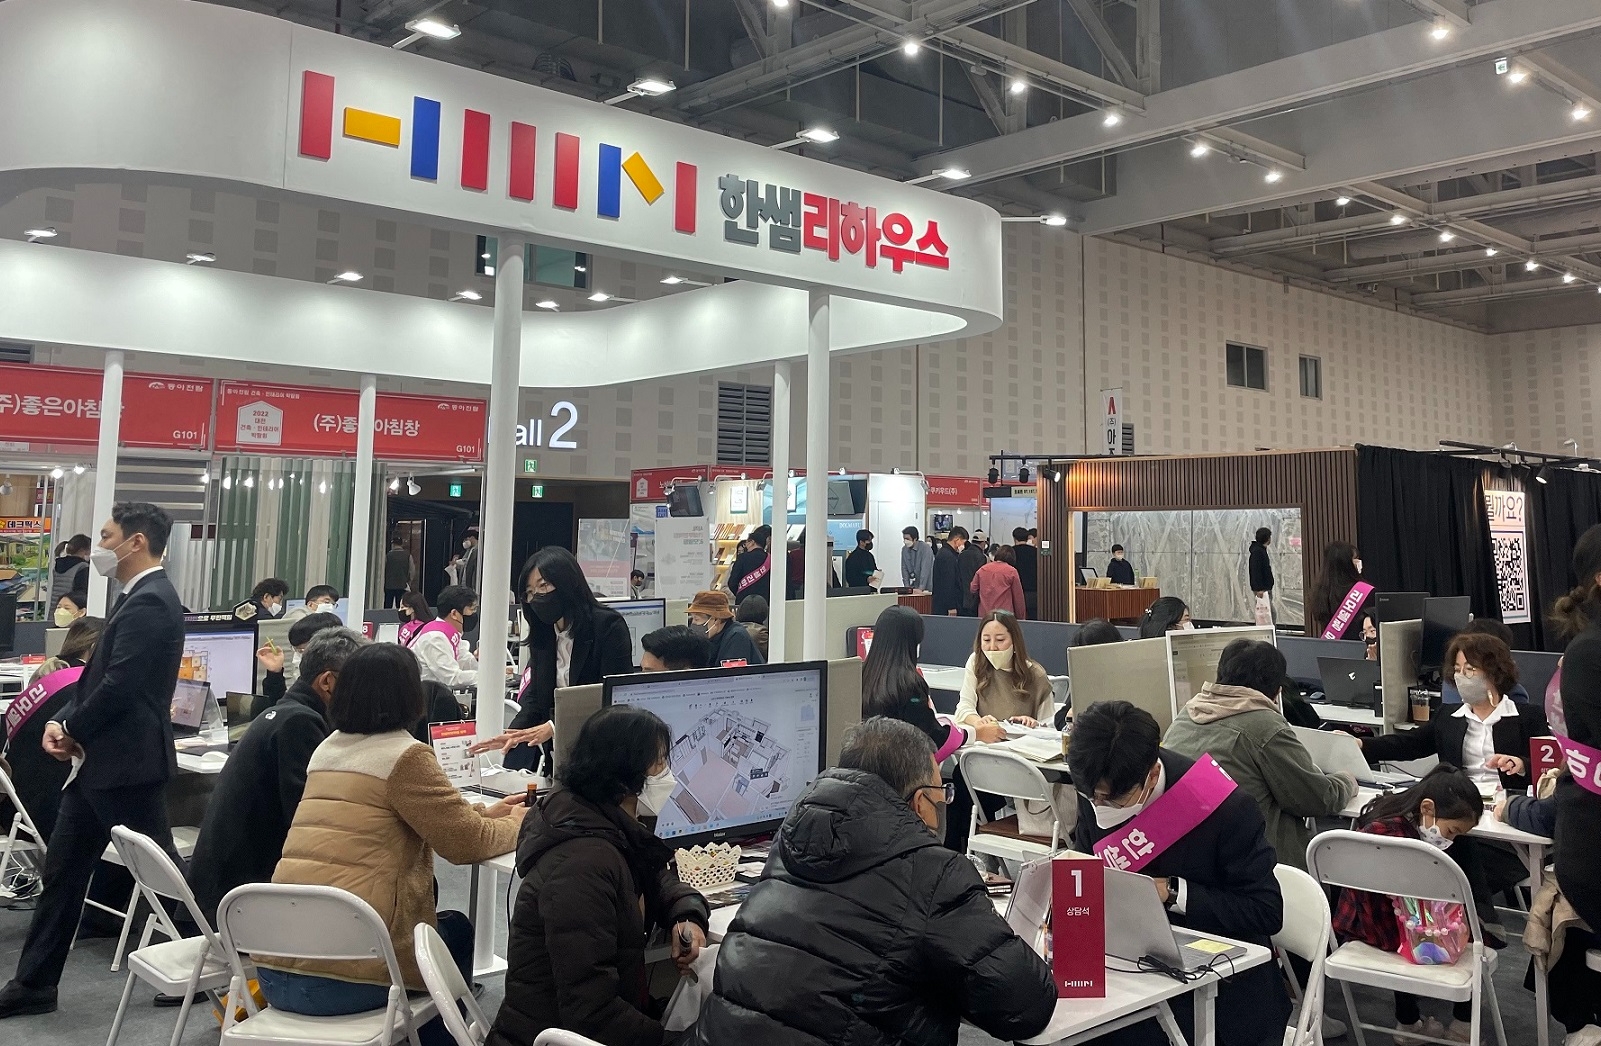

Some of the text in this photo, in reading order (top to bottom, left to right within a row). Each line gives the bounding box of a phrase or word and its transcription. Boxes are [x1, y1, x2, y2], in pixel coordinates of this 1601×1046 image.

[313, 413, 421, 437] (주)좋아침창
[488, 401, 578, 449] all 2
[172, 430, 198, 440] G101
[456, 445, 475, 453] G101
[362, 625, 368, 634] 8
[1540, 745, 1555, 763] 2
[1070, 869, 1083, 898] 1
[1066, 906, 1090, 916] 상담석
